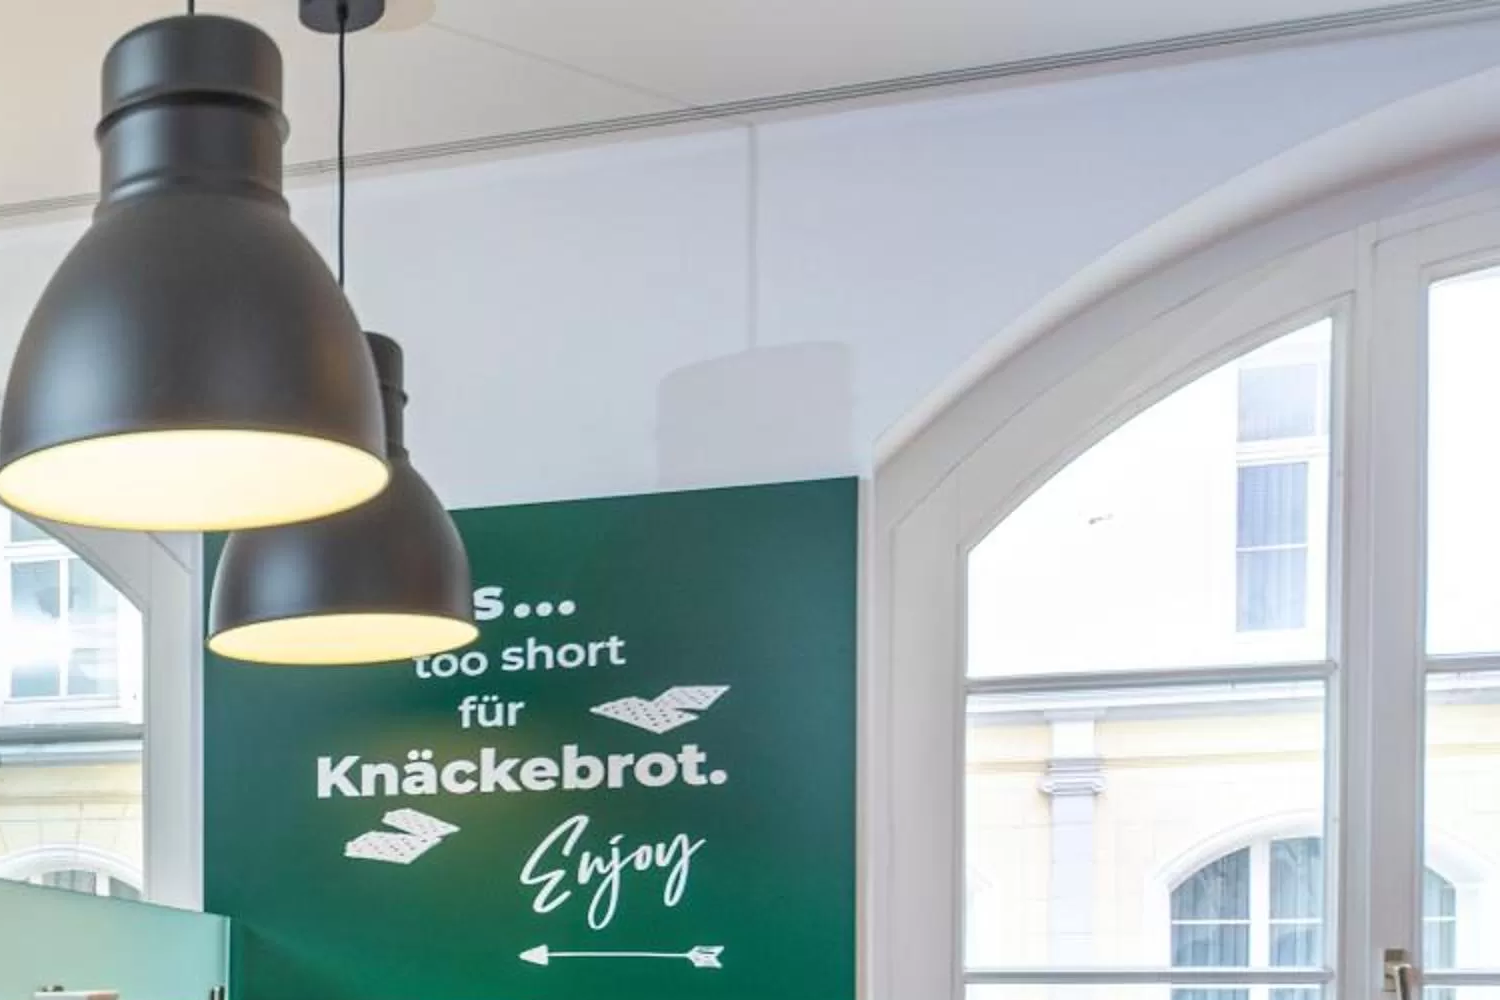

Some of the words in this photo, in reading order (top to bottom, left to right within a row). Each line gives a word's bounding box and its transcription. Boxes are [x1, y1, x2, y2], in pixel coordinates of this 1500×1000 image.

[472, 586, 576, 621] s...
[414, 652, 488, 679] too
[501, 635, 627, 671] short
[458, 695, 525, 729] für
[316, 744, 728, 799] Knäckebrot.
[519, 814, 706, 930] Enjoy
